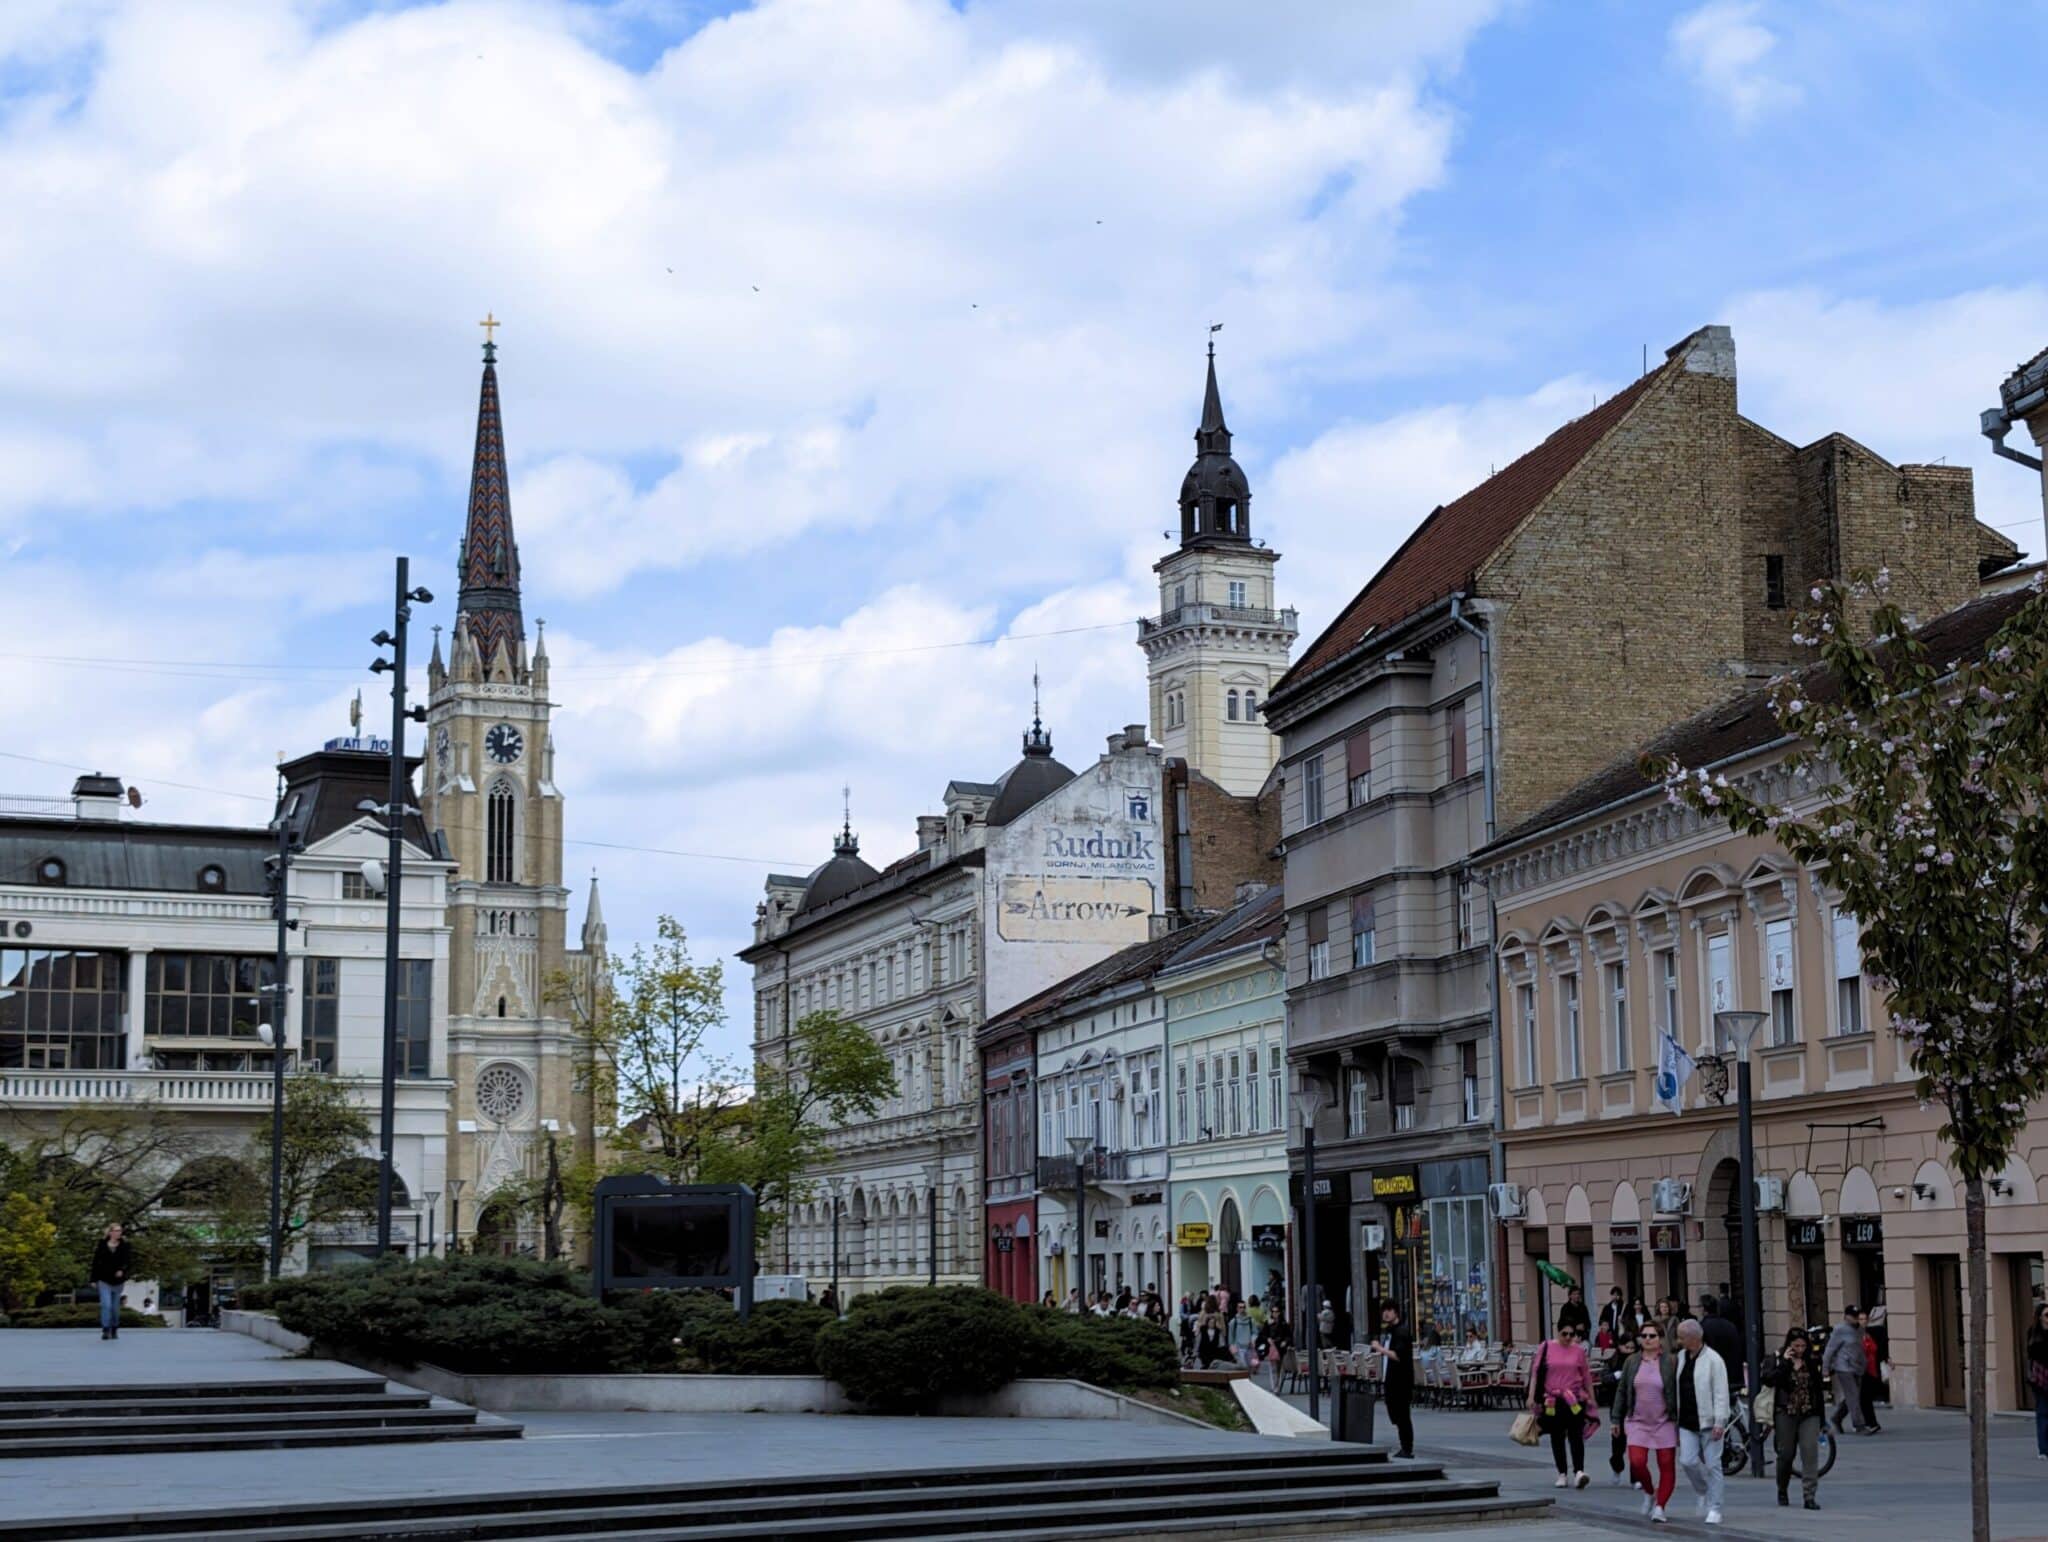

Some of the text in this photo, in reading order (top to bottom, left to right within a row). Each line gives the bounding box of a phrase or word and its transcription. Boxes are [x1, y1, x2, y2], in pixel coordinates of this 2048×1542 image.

[1129, 801, 1148, 820] R
[1043, 827, 1155, 860] Rudnik
[1091, 862, 1156, 871] MILANOVAC
[1027, 890, 1120, 921] Arrow
[1801, 1225, 1816, 1243] LEO
[1857, 1223, 1873, 1241] LEO
